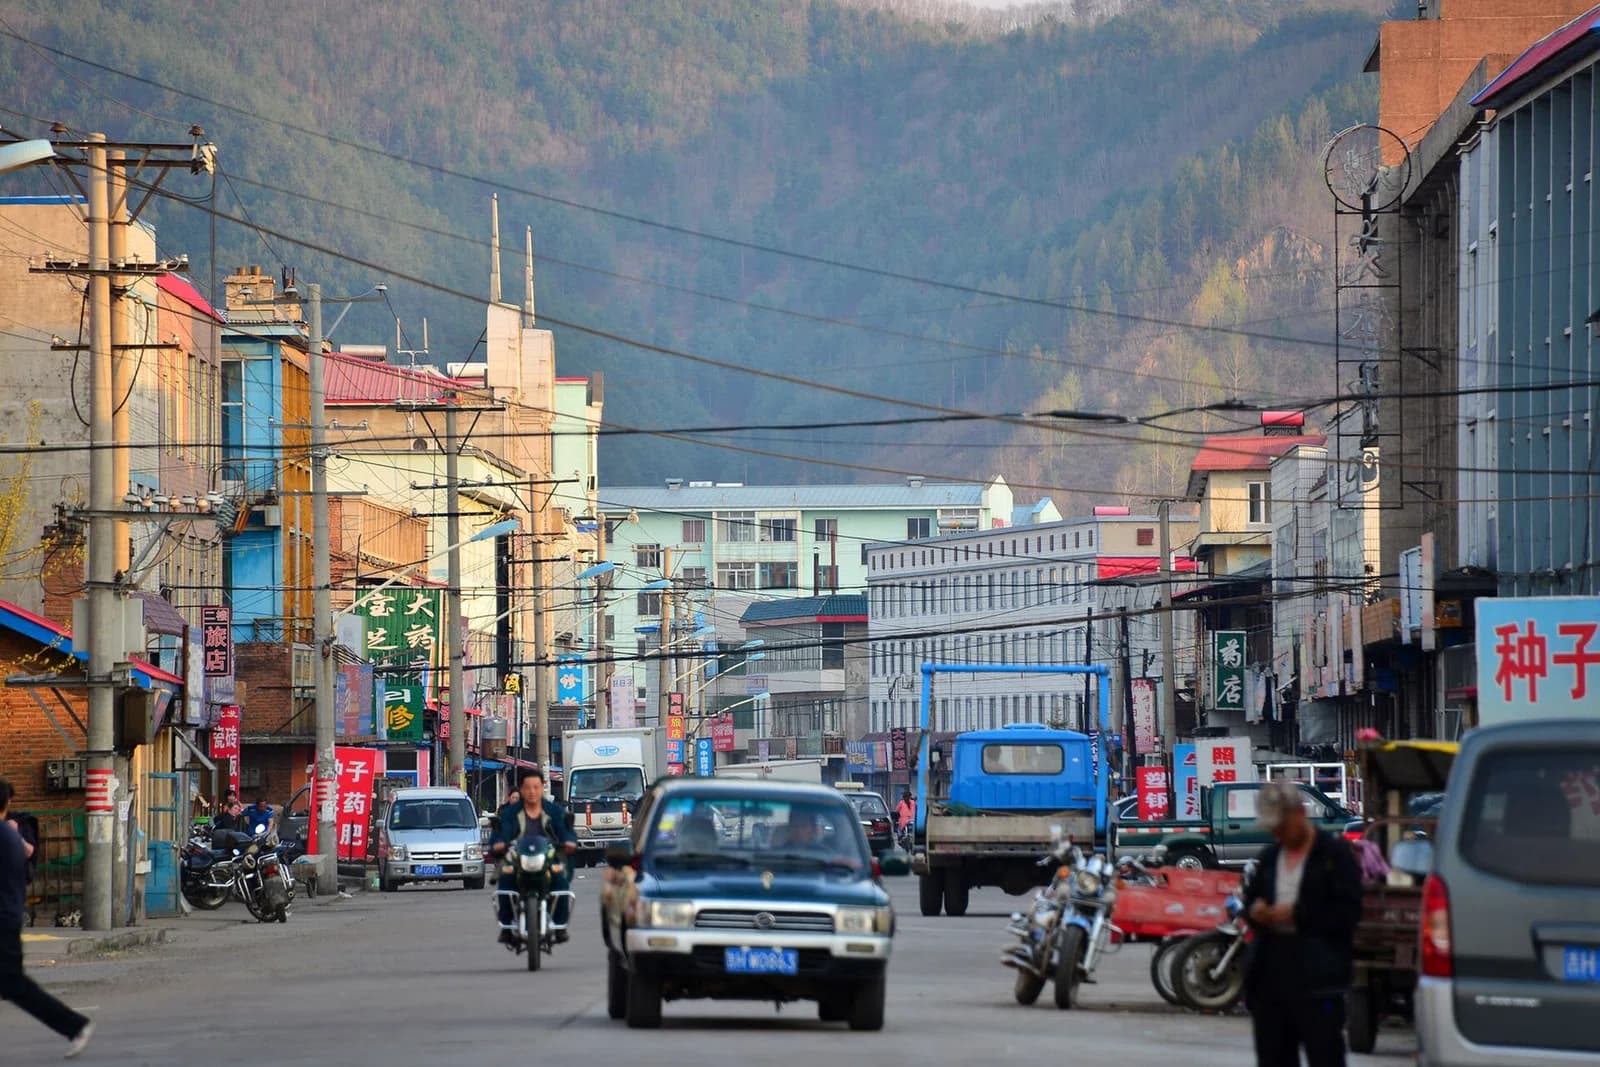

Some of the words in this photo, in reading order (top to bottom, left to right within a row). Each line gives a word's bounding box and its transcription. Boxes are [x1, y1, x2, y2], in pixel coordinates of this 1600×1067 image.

[205, 625, 227, 671] 旅店
[1217, 638, 1242, 704] 药店
[1495, 620, 1600, 703] 种子
[213, 725, 238, 748] 瓷砖
